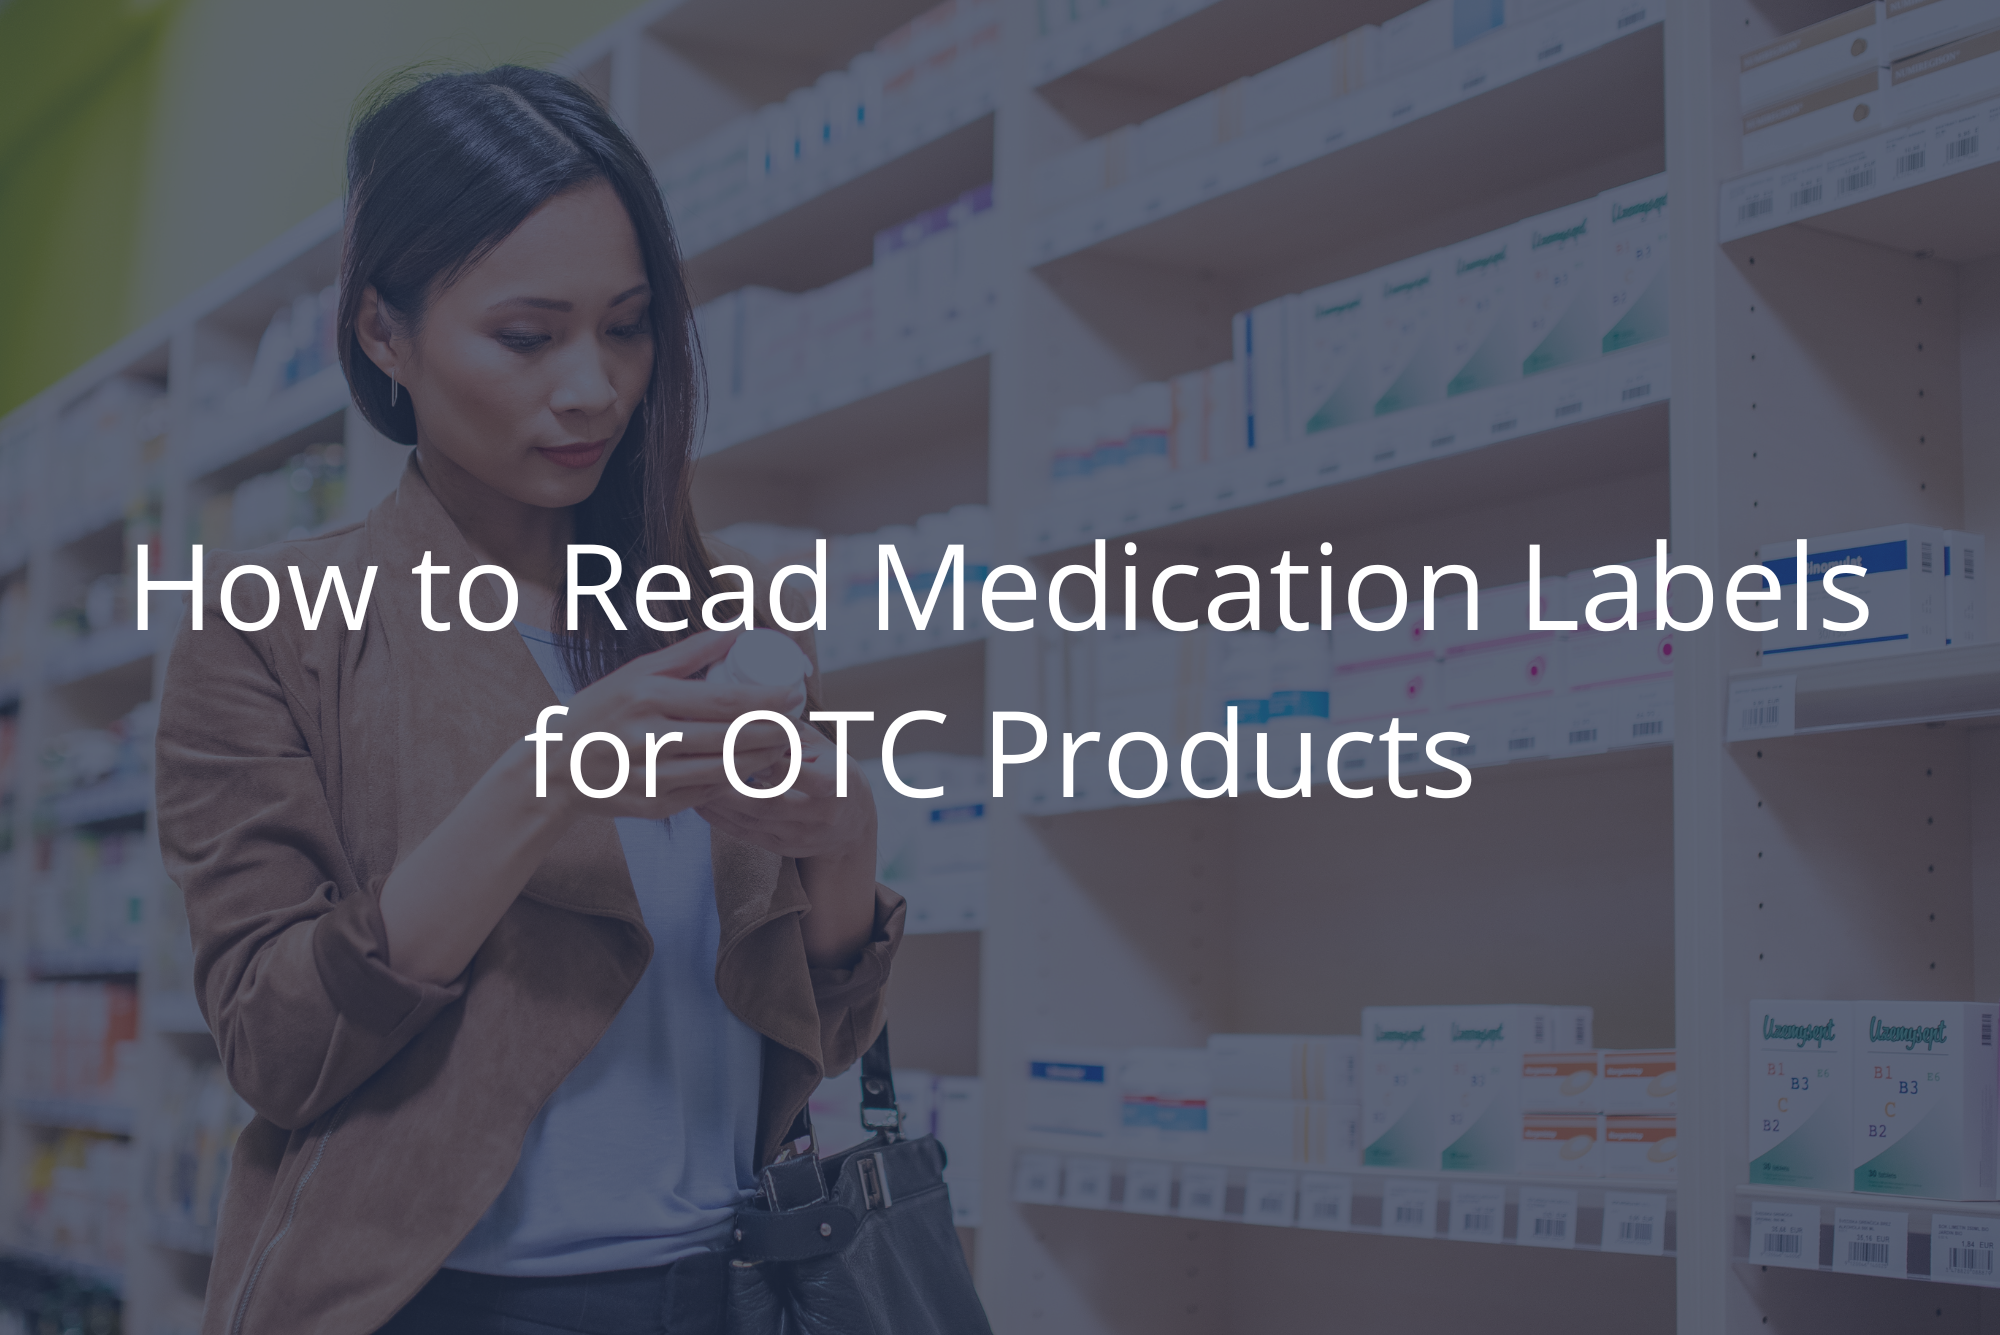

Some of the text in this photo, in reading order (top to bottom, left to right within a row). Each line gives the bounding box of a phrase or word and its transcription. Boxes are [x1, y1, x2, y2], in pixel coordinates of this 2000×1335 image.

[1767, 1062, 1830, 1078] B1 E6
[1874, 1066, 1941, 1082] B1 E6
[1790, 1076, 1810, 1090] B3
[1898, 1080, 1918, 1094] B3
[1777, 1097, 1789, 1113] C
[1884, 1102, 1896, 1118] C
[1762, 1119, 1780, 1132] B2
[1868, 1124, 1887, 1138] B2
[1868, 1169, 1877, 1178] 30
[1980, 1241, 1994, 1249] EUR
